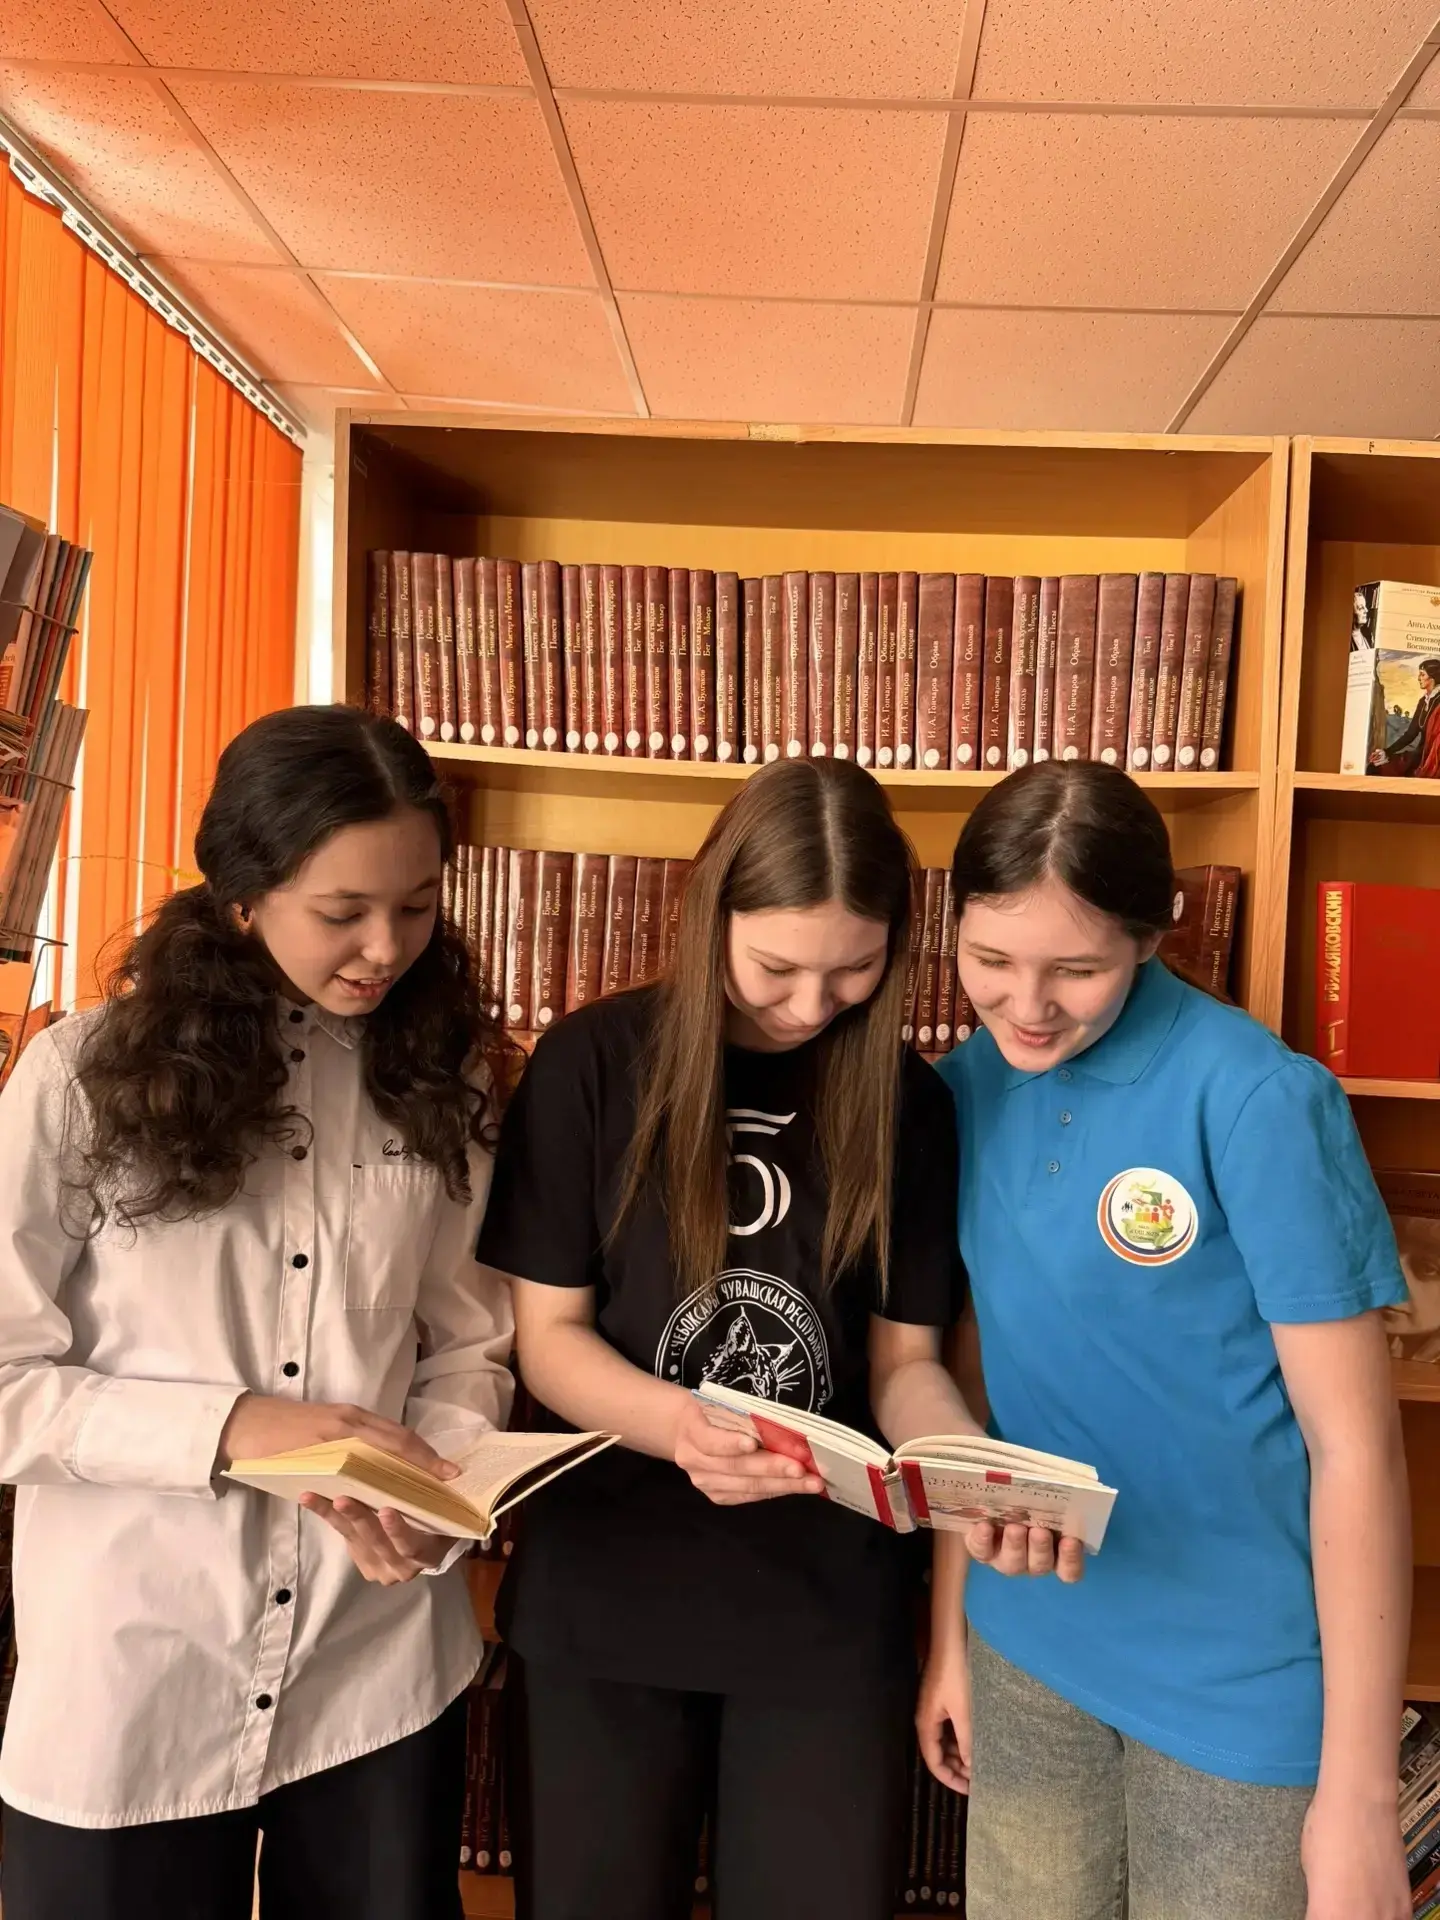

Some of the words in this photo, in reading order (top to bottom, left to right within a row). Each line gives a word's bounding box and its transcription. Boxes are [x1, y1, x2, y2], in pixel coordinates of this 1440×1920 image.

[504, 575, 513, 614] Маргарита
[585, 580, 594, 619] Маргарита
[606, 580, 615, 619] Маргарита
[634, 603, 642, 631] Мольер
[899, 602, 908, 659] Обыкновенная
[1028, 595, 1037, 633] Миргород
[1047, 610, 1056, 634] Пьесы
[880, 605, 889, 662] Обыкновенная
[966, 624, 974, 660] Обломов
[995, 628, 1003, 663] Обломов
[1070, 638, 1079, 665] Обрыв
[930, 641, 939, 668] Обрыв
[1016, 650, 1025, 676] Вечера
[1109, 639, 1119, 666] Обрыв
[882, 676, 891, 712] Гончаров
[901, 673, 910, 709] Гончаров
[1207, 670, 1215, 690] война
[1133, 691, 1143, 737] Гражданская
[1156, 689, 1166, 735] Гражданская
[1181, 690, 1191, 736] Гражданская
[1203, 692, 1213, 738] Гражданская
[542, 890, 551, 915] Братья
[552, 873, 561, 916] Карамазовы
[588, 875, 597, 918] Карамазовы
[614, 896, 624, 920] Идиот
[641, 899, 650, 922] Идиот
[670, 898, 679, 921] Идиот
[933, 886, 942, 919] Рассказы
[1210, 880, 1224, 936] Преступление
[1224, 891, 1233, 931] наказание
[638, 933, 648, 980] Достоевский
[931, 924, 940, 953] Повести
[515, 941, 523, 974] Гончаров
[720, 1279, 787, 1311] ЧУВАШСКАЯ
[786, 1300, 824, 1371] РЕСПУБЛИКА
